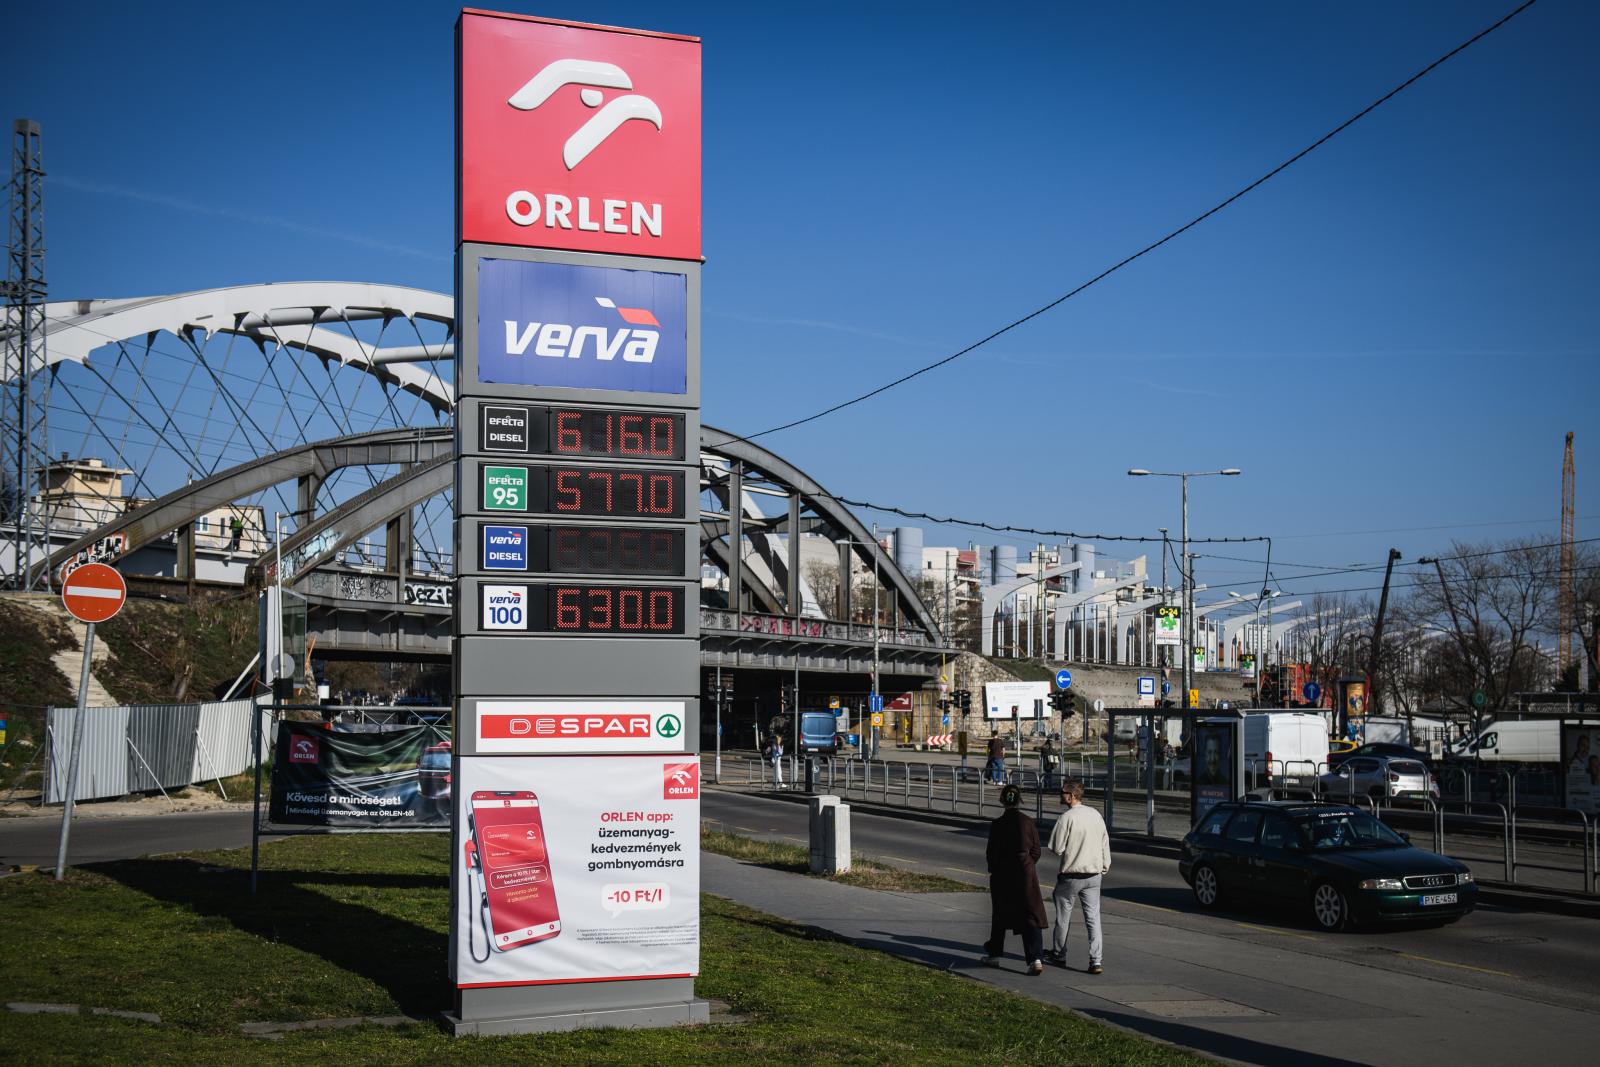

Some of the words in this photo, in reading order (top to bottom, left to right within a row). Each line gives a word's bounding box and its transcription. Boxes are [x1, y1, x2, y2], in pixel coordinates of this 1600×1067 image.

[505, 190, 663, 238] ORLEN
[504, 319, 660, 364] verva
[489, 433, 524, 443] DIESEL
[557, 411, 674, 456] 616.0
[492, 488, 519, 506] 95
[556, 470, 673, 514] 577.0
[489, 535, 522, 546] verva
[489, 552, 523, 561] DIESEL
[489, 595, 521, 605] verva
[489, 607, 522, 625] 100
[556, 588, 673, 630] 630.0
[1159, 607, 1179, 616] 0-24
[509, 718, 650, 735] DESPAR
[286, 791, 328, 803] Kövesd
[329, 795, 337, 804] a
[600, 812, 644, 822] ORLEN
[647, 812, 673, 823] app:
[598, 827, 675, 839] üzemanyag-
[591, 841, 682, 854] kedvezmények
[588, 857, 684, 872] gombnyomásra
[607, 889, 631, 903] -10
[634, 887, 663, 903] Ft/l
[1424, 894, 1457, 905] PYE-452
